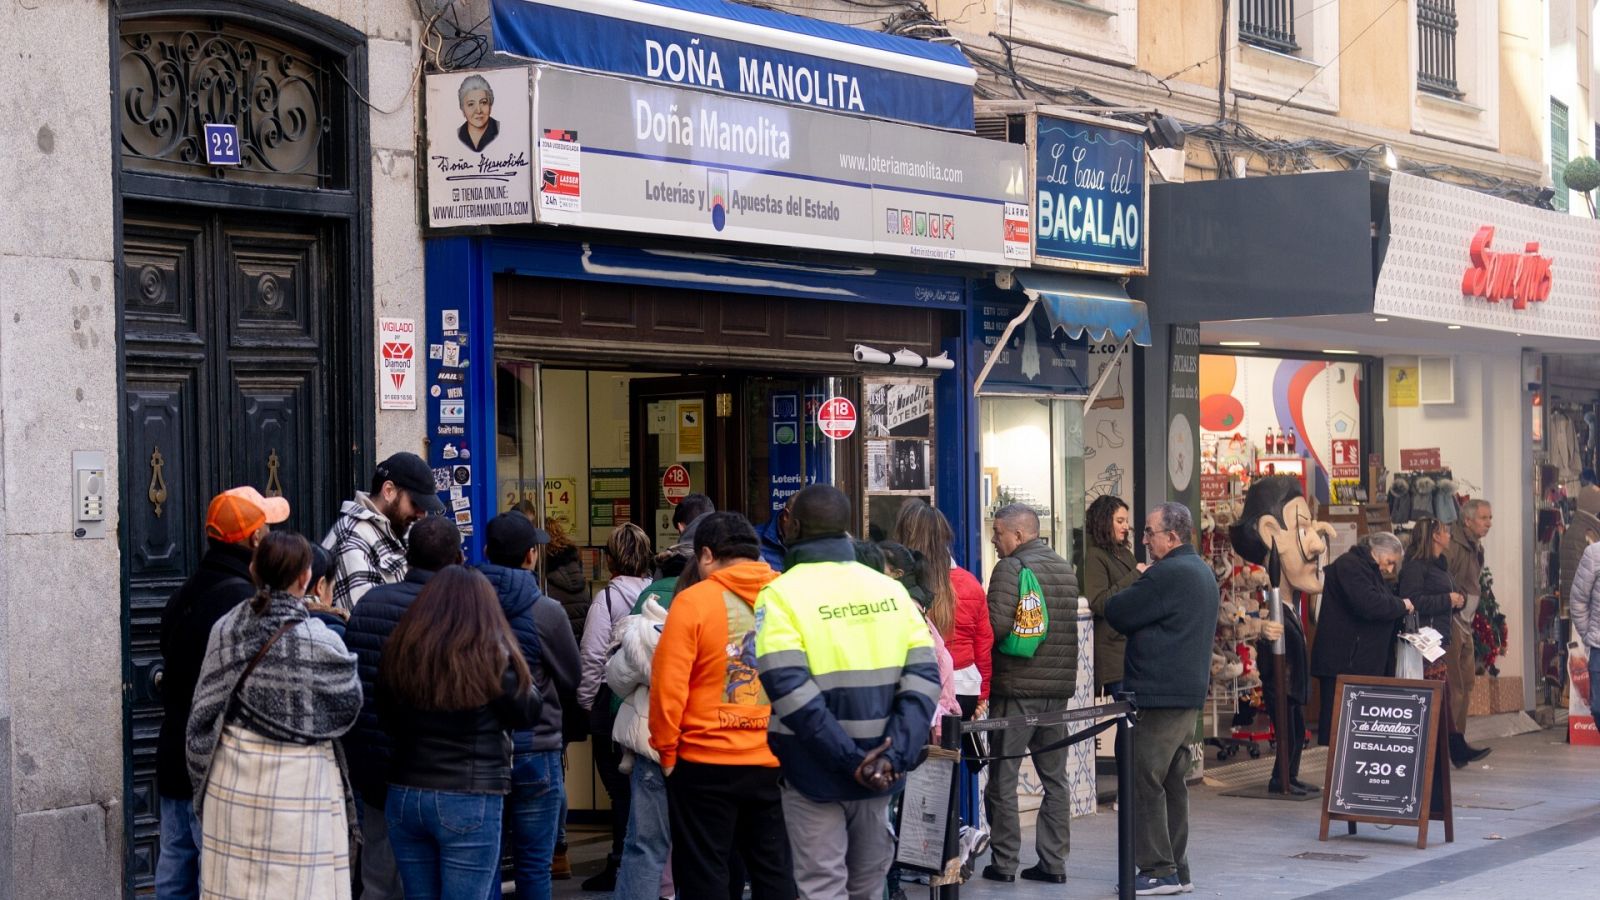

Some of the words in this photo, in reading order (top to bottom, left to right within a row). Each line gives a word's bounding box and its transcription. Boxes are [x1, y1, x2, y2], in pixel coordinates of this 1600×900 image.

[645, 38, 725, 90] DOÑA
[739, 59, 865, 112] MANOLITA
[635, 99, 694, 142] Doña
[699, 108, 790, 160] Manolita
[212, 132, 234, 156] 22
[432, 155, 473, 172] Doña
[839, 151, 964, 184] www.loteriamanolita.com
[1047, 143, 1068, 185] La
[1072, 146, 1105, 191] Casa
[1110, 157, 1132, 195] del
[461, 188, 483, 201] TIENDA
[545, 195, 558, 206] 24h
[645, 179, 695, 207] Loterías
[697, 190, 706, 212] y
[731, 188, 783, 217] Apuestas
[786, 193, 801, 217] del
[804, 196, 840, 222] Estado
[432, 201, 529, 220] WWW.LOTERIAMANOLITA.COM
[1038, 190, 1139, 248] BACALAO
[382, 321, 414, 333] VIGILADO
[667, 469, 684, 483] +18
[1360, 705, 1413, 719] LOMOS
[1359, 722, 1370, 731] de
[1371, 720, 1411, 734] bacalao
[1353, 741, 1414, 754] DESALADOS
[1355, 761, 1392, 776] 7,30
[1395, 765, 1407, 777] €
